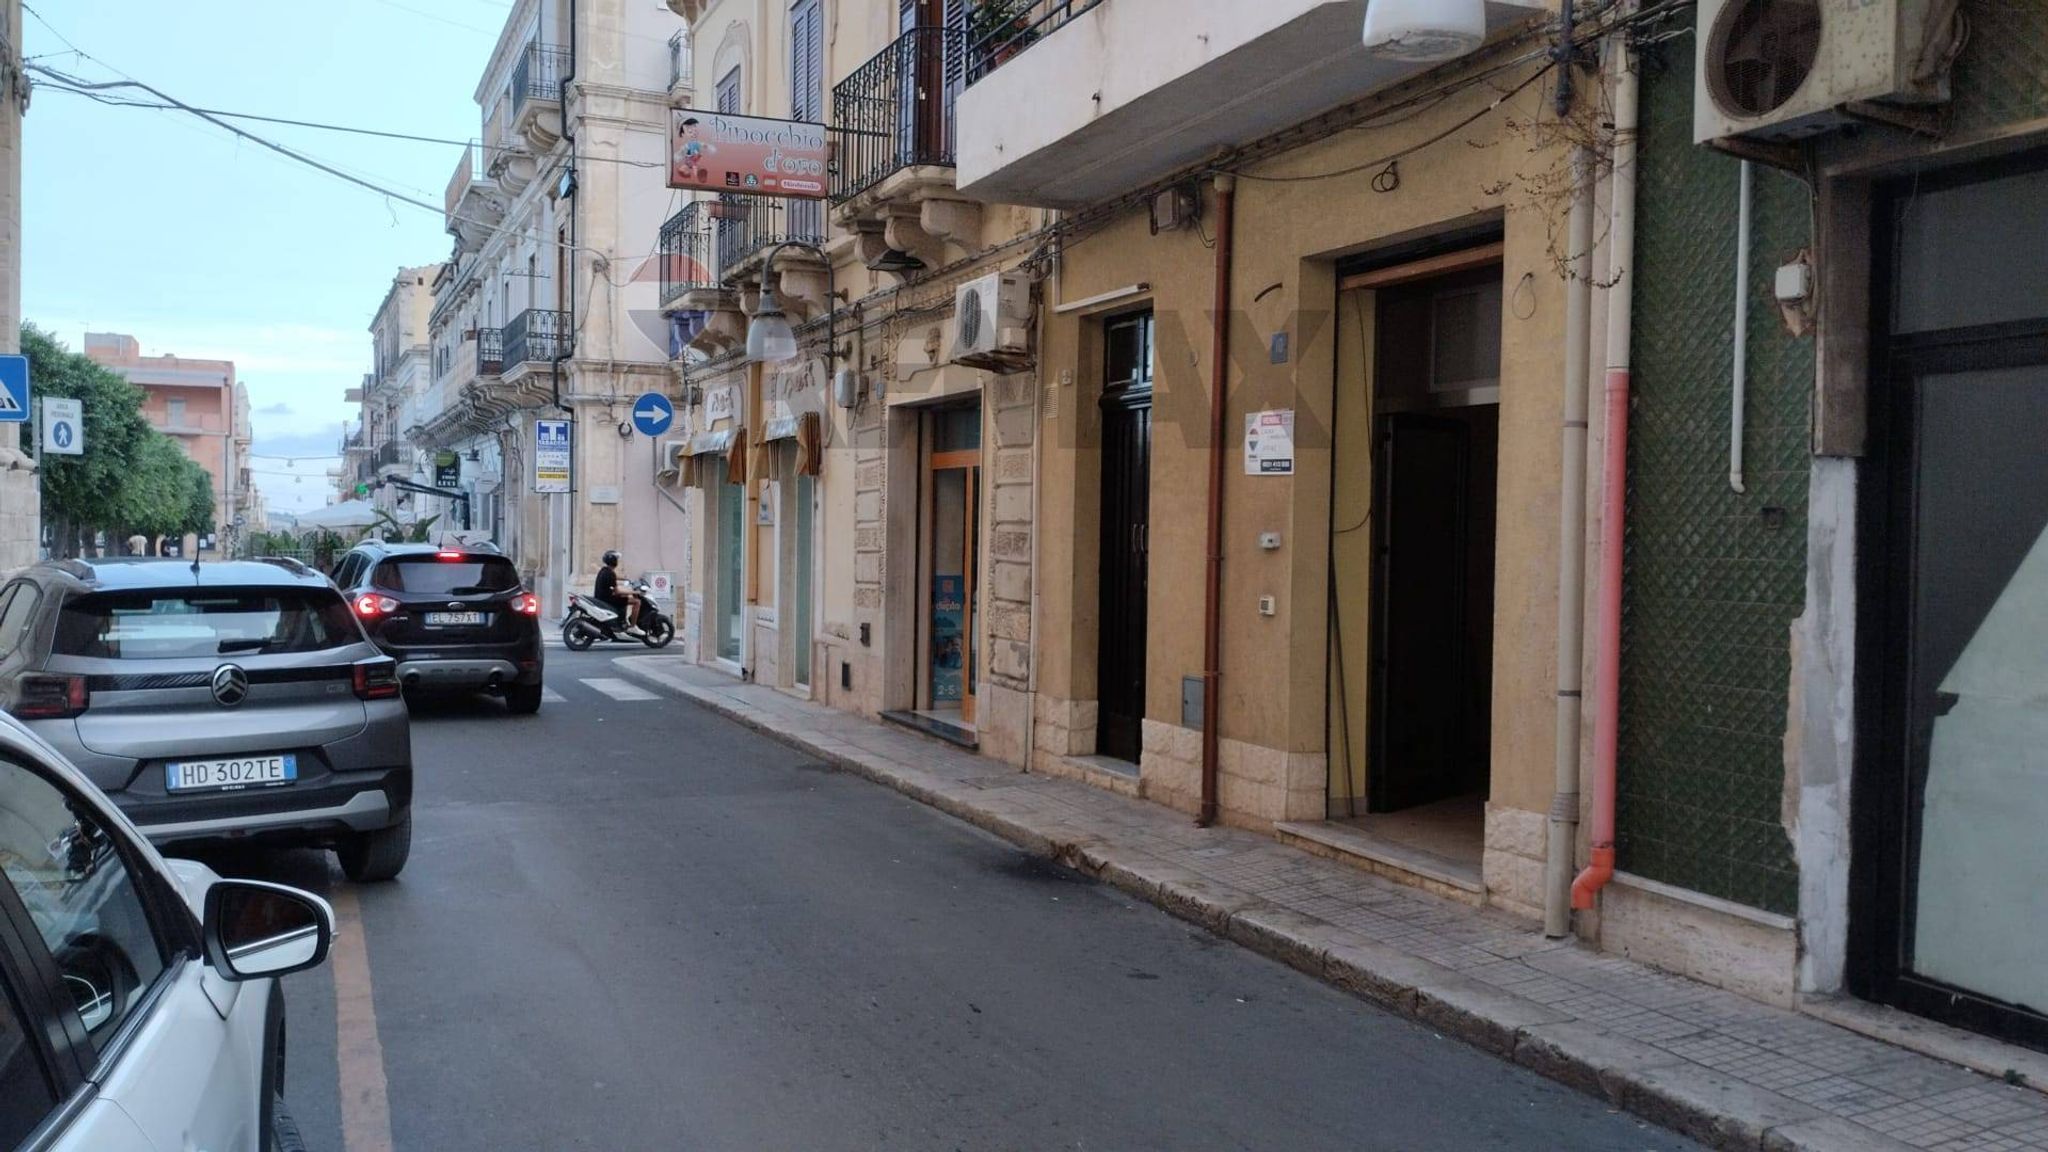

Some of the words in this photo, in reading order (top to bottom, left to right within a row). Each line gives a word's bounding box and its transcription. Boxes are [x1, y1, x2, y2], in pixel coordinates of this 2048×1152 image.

[709, 116, 823, 150] Pinocchio
[764, 148, 823, 177] d'oro
[183, 764, 208, 785] HD
[216, 759, 281, 782] 302TE
